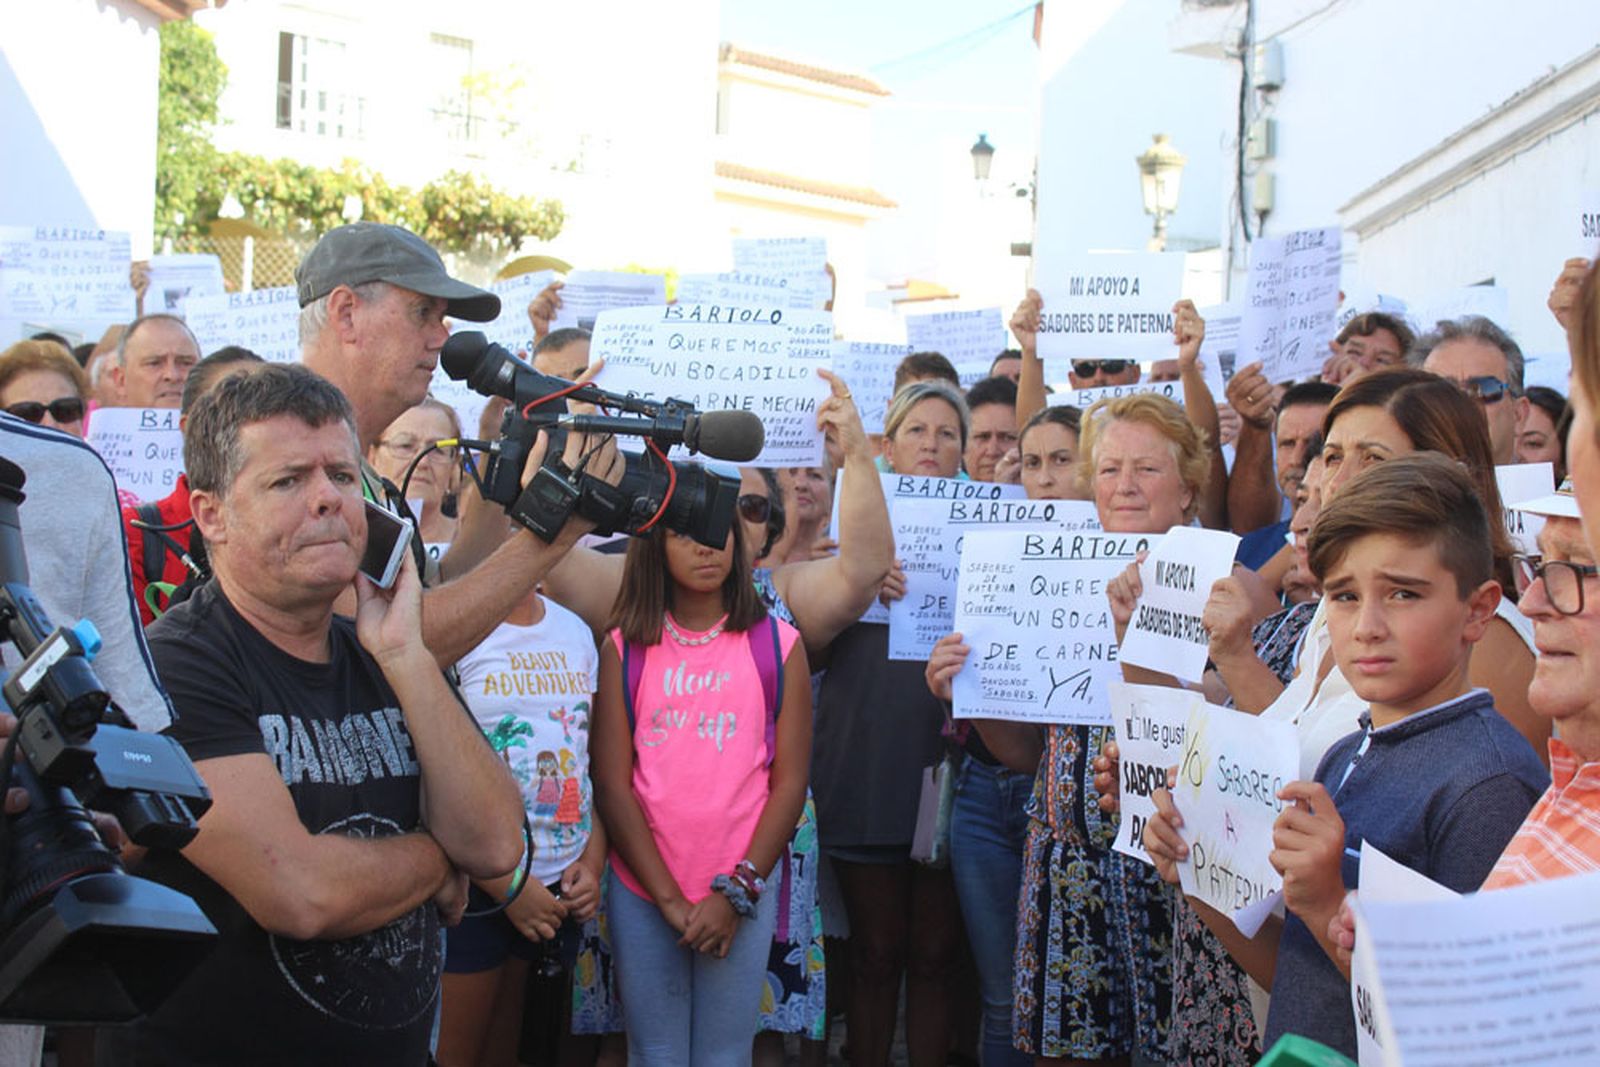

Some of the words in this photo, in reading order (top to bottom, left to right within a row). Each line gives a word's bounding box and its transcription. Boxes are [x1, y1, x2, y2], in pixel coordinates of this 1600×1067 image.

[1069, 277, 1083, 295] MI
[1086, 276, 1128, 295] APOYO
[1131, 277, 1140, 295] A
[228, 289, 298, 308] BARTOL
[664, 305, 783, 325] BARTOLO
[1039, 313, 1094, 333] SABORES
[1098, 313, 1115, 333] DE
[1117, 313, 1173, 333] PATERNA
[668, 333, 781, 354] QUEREMOS
[650, 361, 676, 378] UN
[687, 361, 808, 382] BOCADILLO
[762, 395, 815, 413] MECHA
[897, 476, 1001, 500] BARTOLO
[949, 503, 1056, 522] BARTOLO
[1023, 534, 1149, 558] BARTOLO
[1030, 574, 1100, 597] QUERE
[920, 594, 948, 610] DE
[1013, 609, 1040, 628] UN
[1136, 604, 1172, 637] SABORES
[506, 651, 568, 671] BEAUTY
[984, 642, 1018, 661] DE
[1035, 643, 1118, 662] CARNE
[697, 711, 736, 753] up
[1143, 717, 1159, 742] Me
[1162, 723, 1185, 750] gust
[258, 707, 420, 786] RAMONE
[1123, 760, 1172, 798] SABOR
[1192, 841, 1276, 911] PATERN
